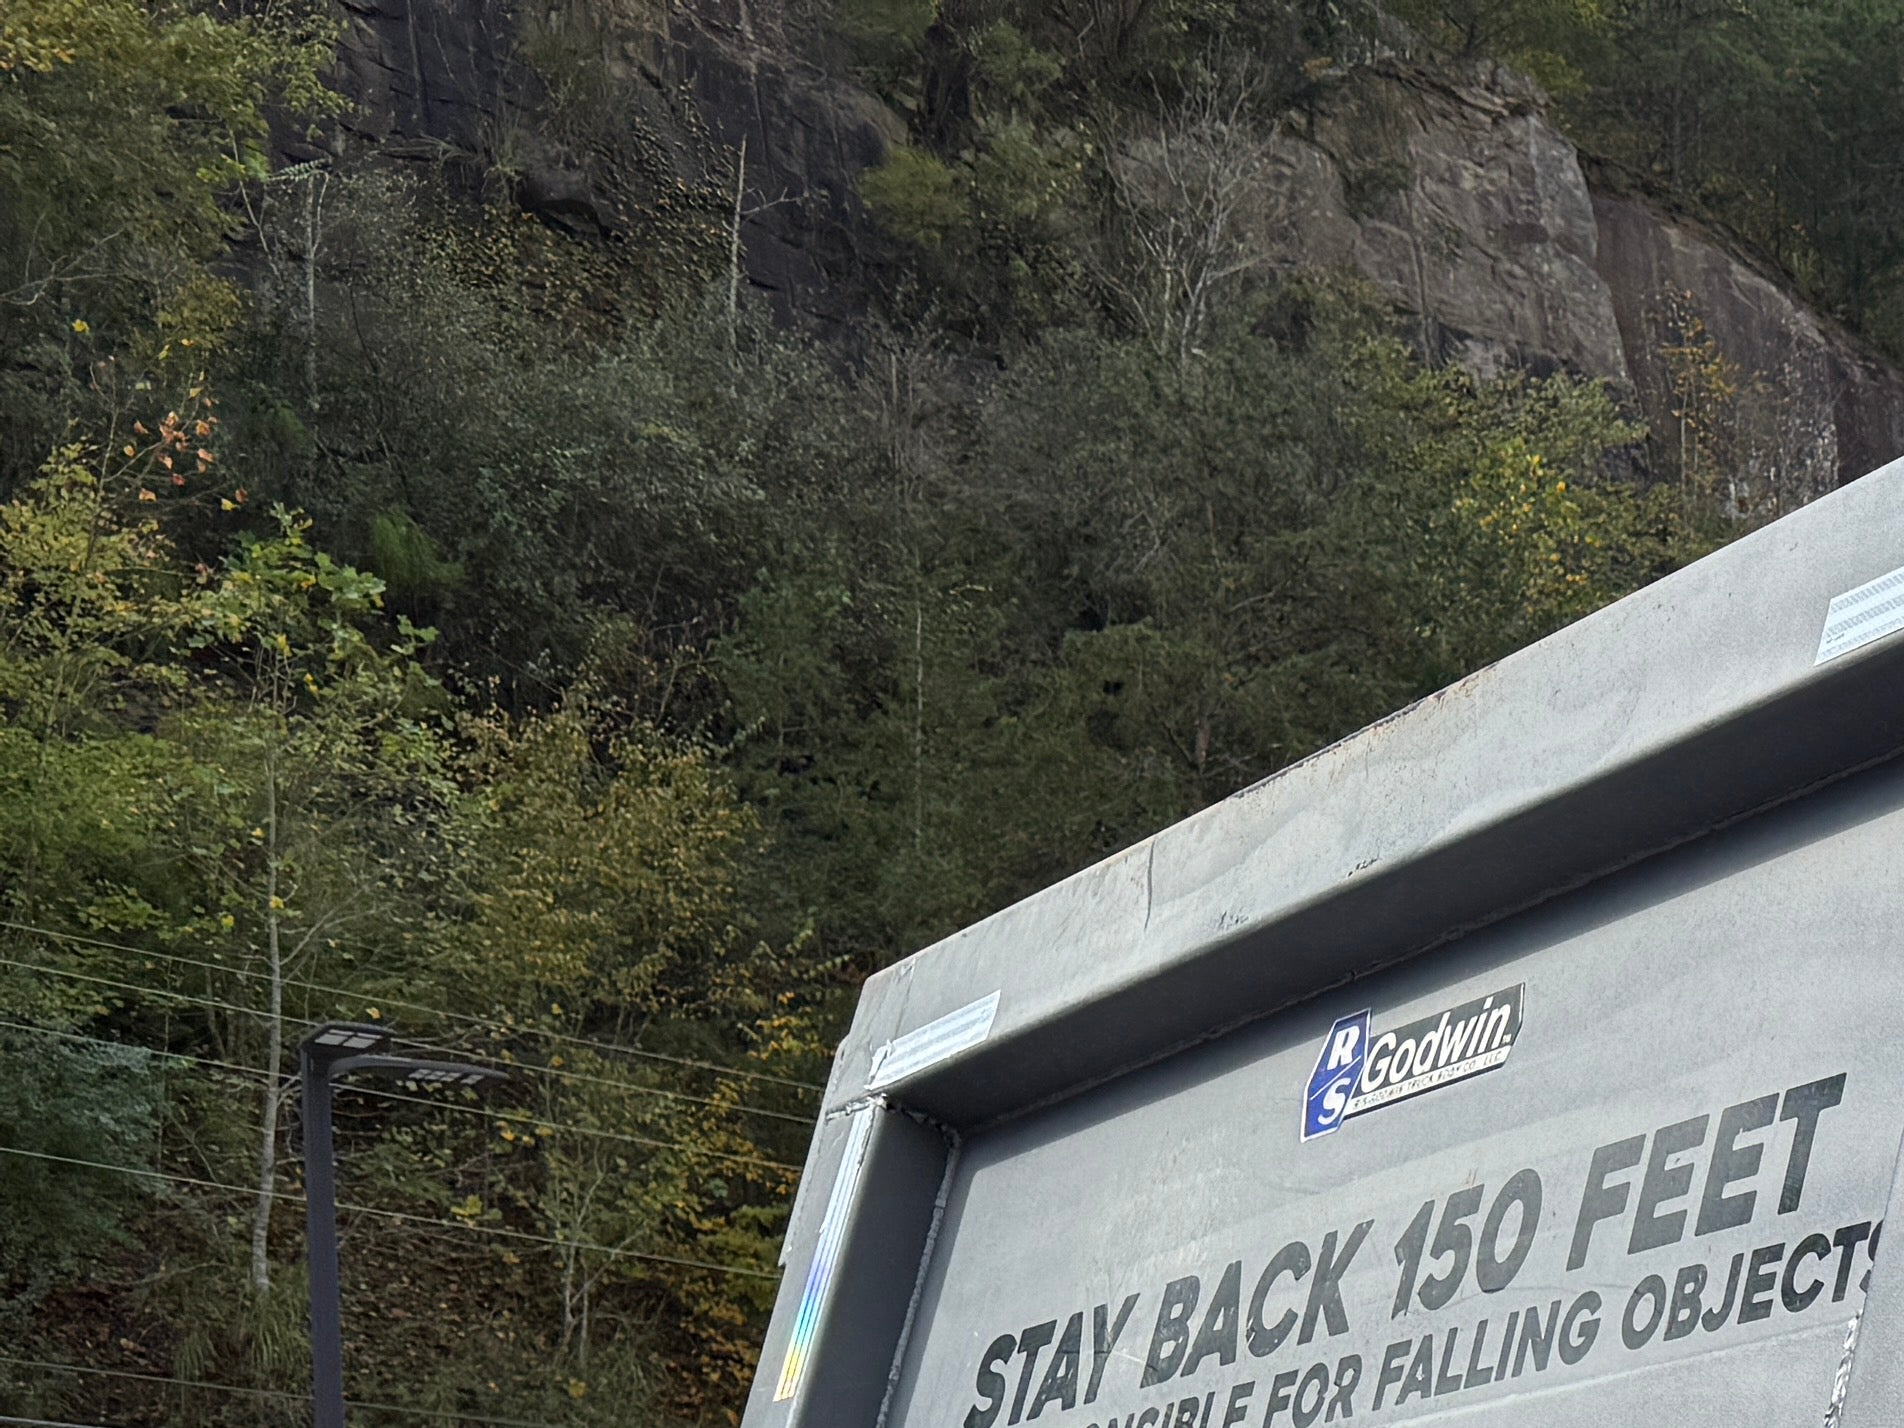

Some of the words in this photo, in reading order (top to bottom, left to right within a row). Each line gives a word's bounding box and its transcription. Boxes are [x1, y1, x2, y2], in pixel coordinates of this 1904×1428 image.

[1360, 996, 1512, 1094] Godwin
[1139, 1218, 1375, 1389] BACK
[1390, 1168, 1543, 1321] 150
[1566, 1072, 1847, 1272] FEET
[1371, 1289, 1603, 1412] FALLING
